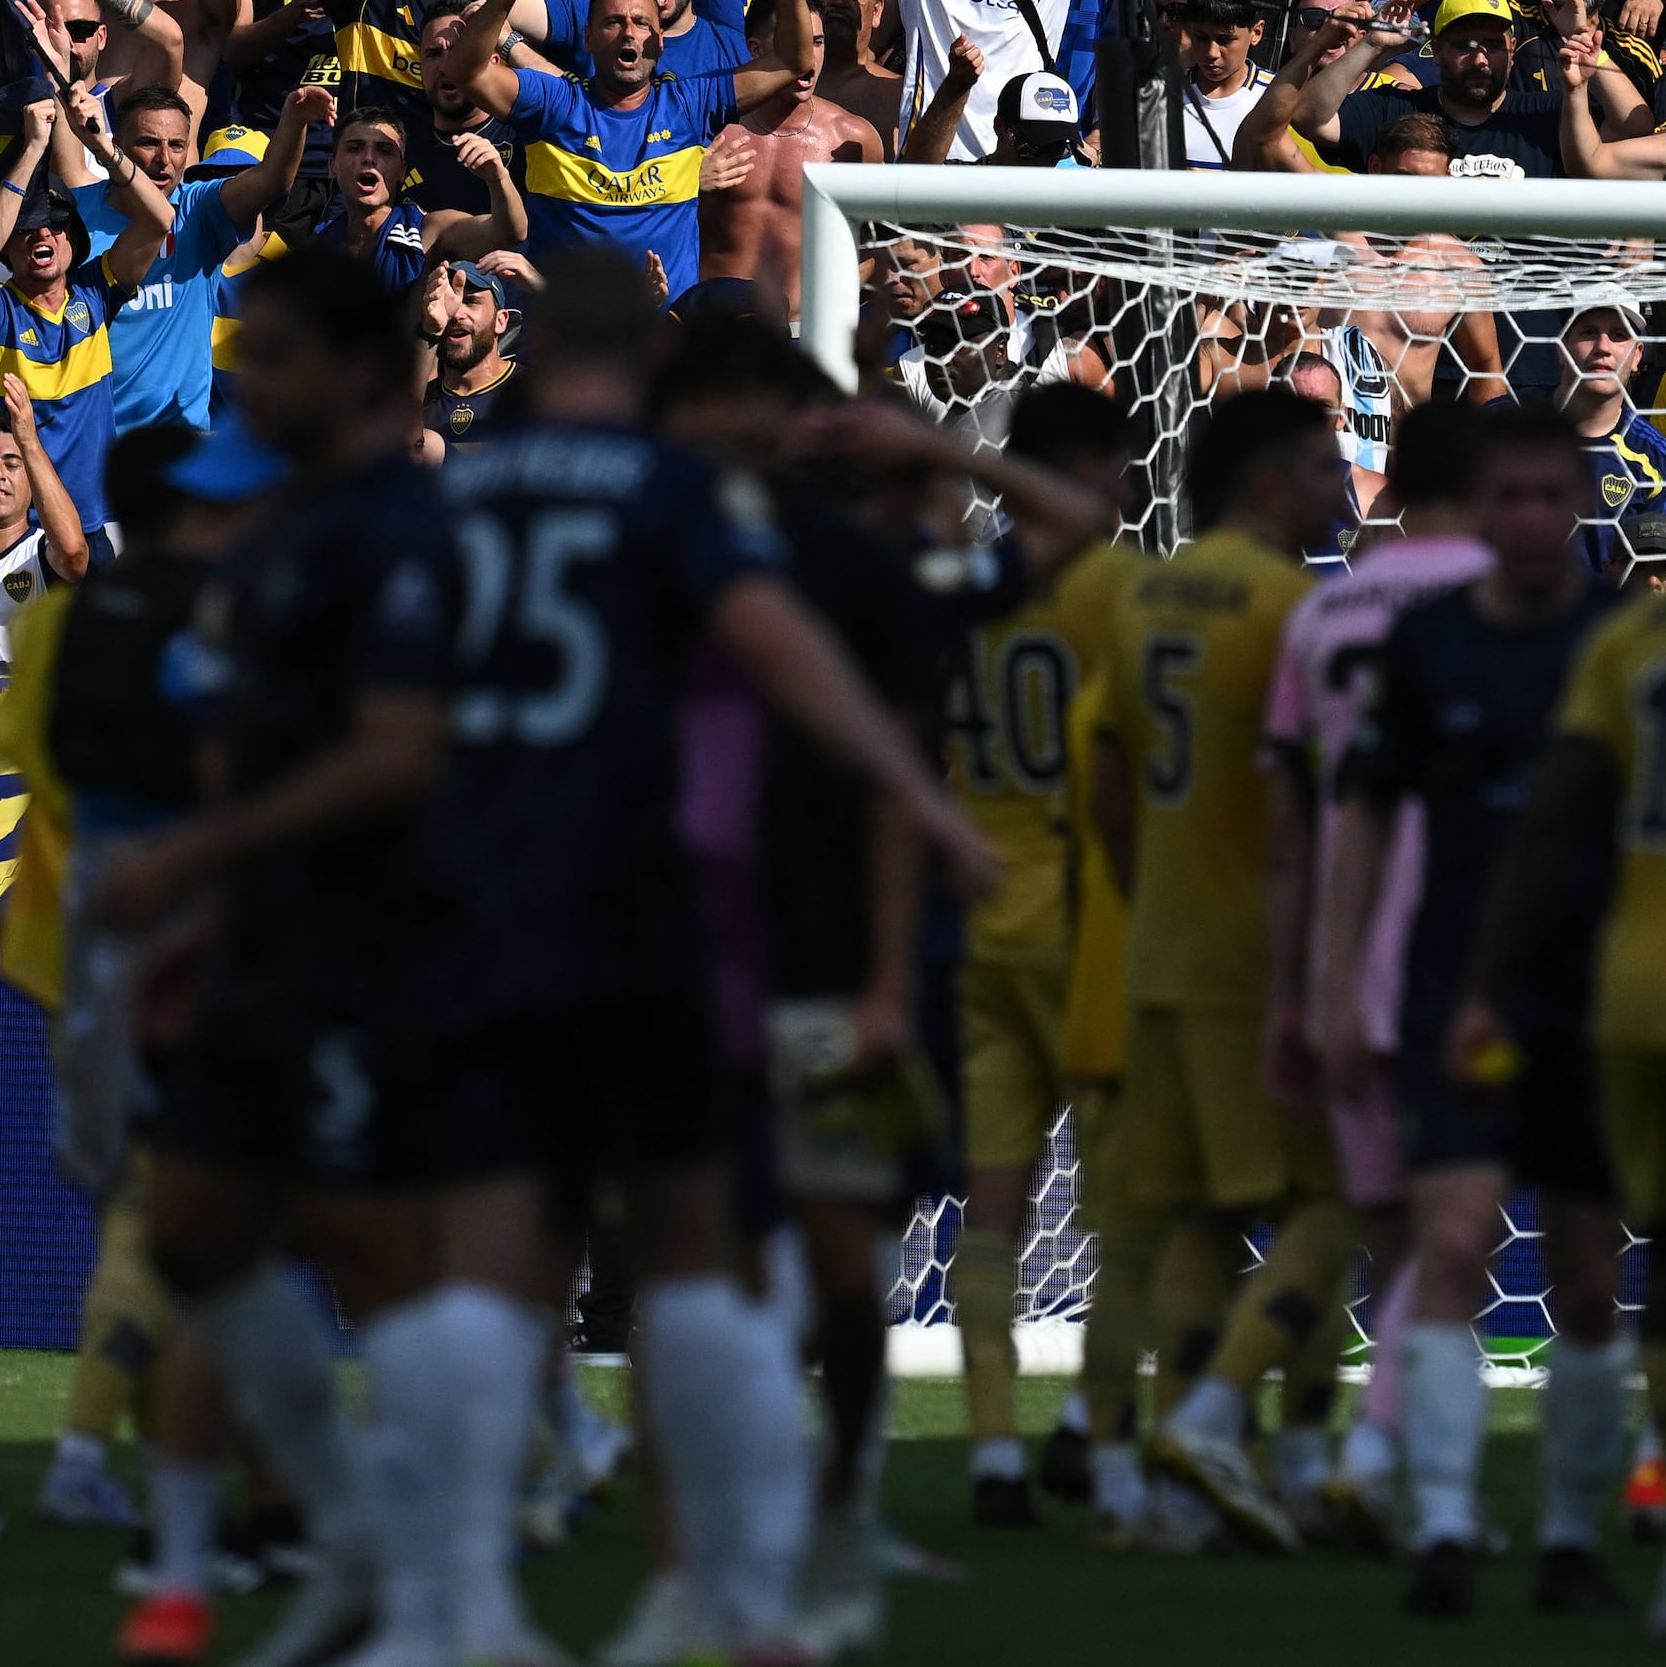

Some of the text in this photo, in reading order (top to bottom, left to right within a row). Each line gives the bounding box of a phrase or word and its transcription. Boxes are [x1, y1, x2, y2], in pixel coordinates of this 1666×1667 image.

[587, 165, 662, 195] QATAR
[604, 185, 666, 204] AIRWAYS
[1605, 484, 1627, 495] CABJ
[5, 580, 29, 591] CABJ
[948, 629, 1075, 793] 40
[1141, 638, 1203, 801] 5
